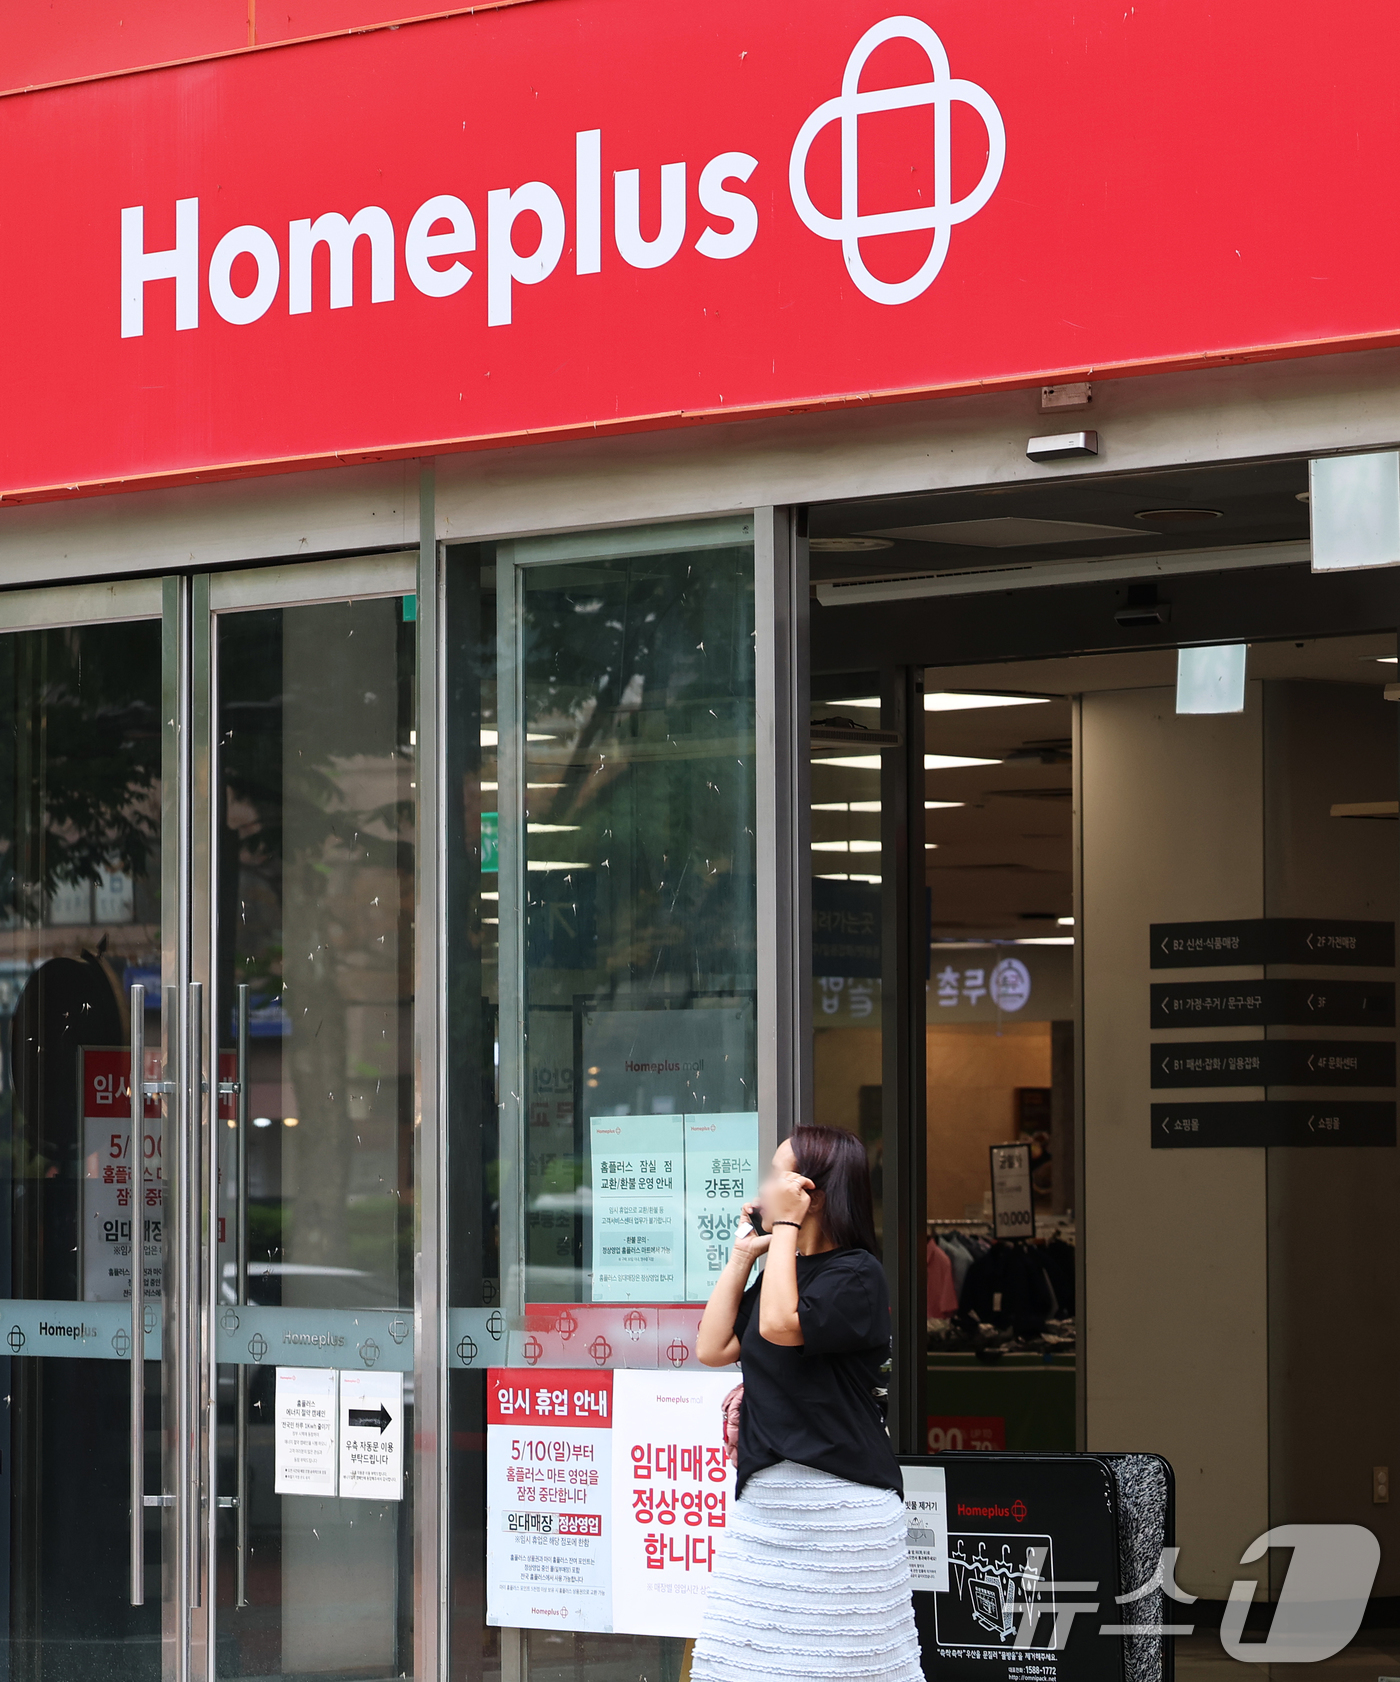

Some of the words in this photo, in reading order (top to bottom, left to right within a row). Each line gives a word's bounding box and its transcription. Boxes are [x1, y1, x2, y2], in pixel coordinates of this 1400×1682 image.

[121, 128, 759, 338] Homeplus
[1173, 940, 1184, 950] B2
[625, 1060, 680, 1074] Homeplus
[1174, 1119, 1200, 1131] 쇼핑몰
[601, 1160, 634, 1173] 홈플러스
[640, 1160, 656, 1172] 잠실
[664, 1160, 672, 1172] 점
[712, 1158, 751, 1173] 홈플러스
[601, 1178, 636, 1190] 교환/환불
[638, 1178, 654, 1190] 운영
[656, 1177, 673, 1190] 안내
[705, 1179, 744, 1198] 강동점
[39, 1322, 97, 1342] Homeplus
[282, 1330, 345, 1348] Homeplus
[498, 1388, 530, 1416] 임시
[536, 1388, 568, 1416] 휴업
[574, 1390, 608, 1417] 안내
[656, 1394, 689, 1404] Homeplus
[360, 1442, 379, 1453] 자동문
[381, 1442, 394, 1454] 이용
[512, 1439, 594, 1463] 5/10(일)부터
[351, 1454, 388, 1465] 부탁드립니다
[631, 1443, 729, 1483] 임대매장
[506, 1466, 544, 1483] 홈플러스
[548, 1468, 566, 1484] 마트
[569, 1468, 599, 1485] 영업을
[517, 1486, 536, 1502] 잠정
[539, 1487, 587, 1504] 중단합니다
[632, 1488, 726, 1528] 정상영업
[919, 1501, 938, 1511] 제거기
[957, 1504, 1010, 1518] Homeplus
[507, 1514, 552, 1532] 임대매장
[559, 1517, 599, 1534] 정상영업
[532, 1536, 548, 1546] 휴업은
[550, 1537, 560, 1546] 해당
[644, 1533, 715, 1572] 합니다
[531, 1607, 559, 1616] Homeplus
